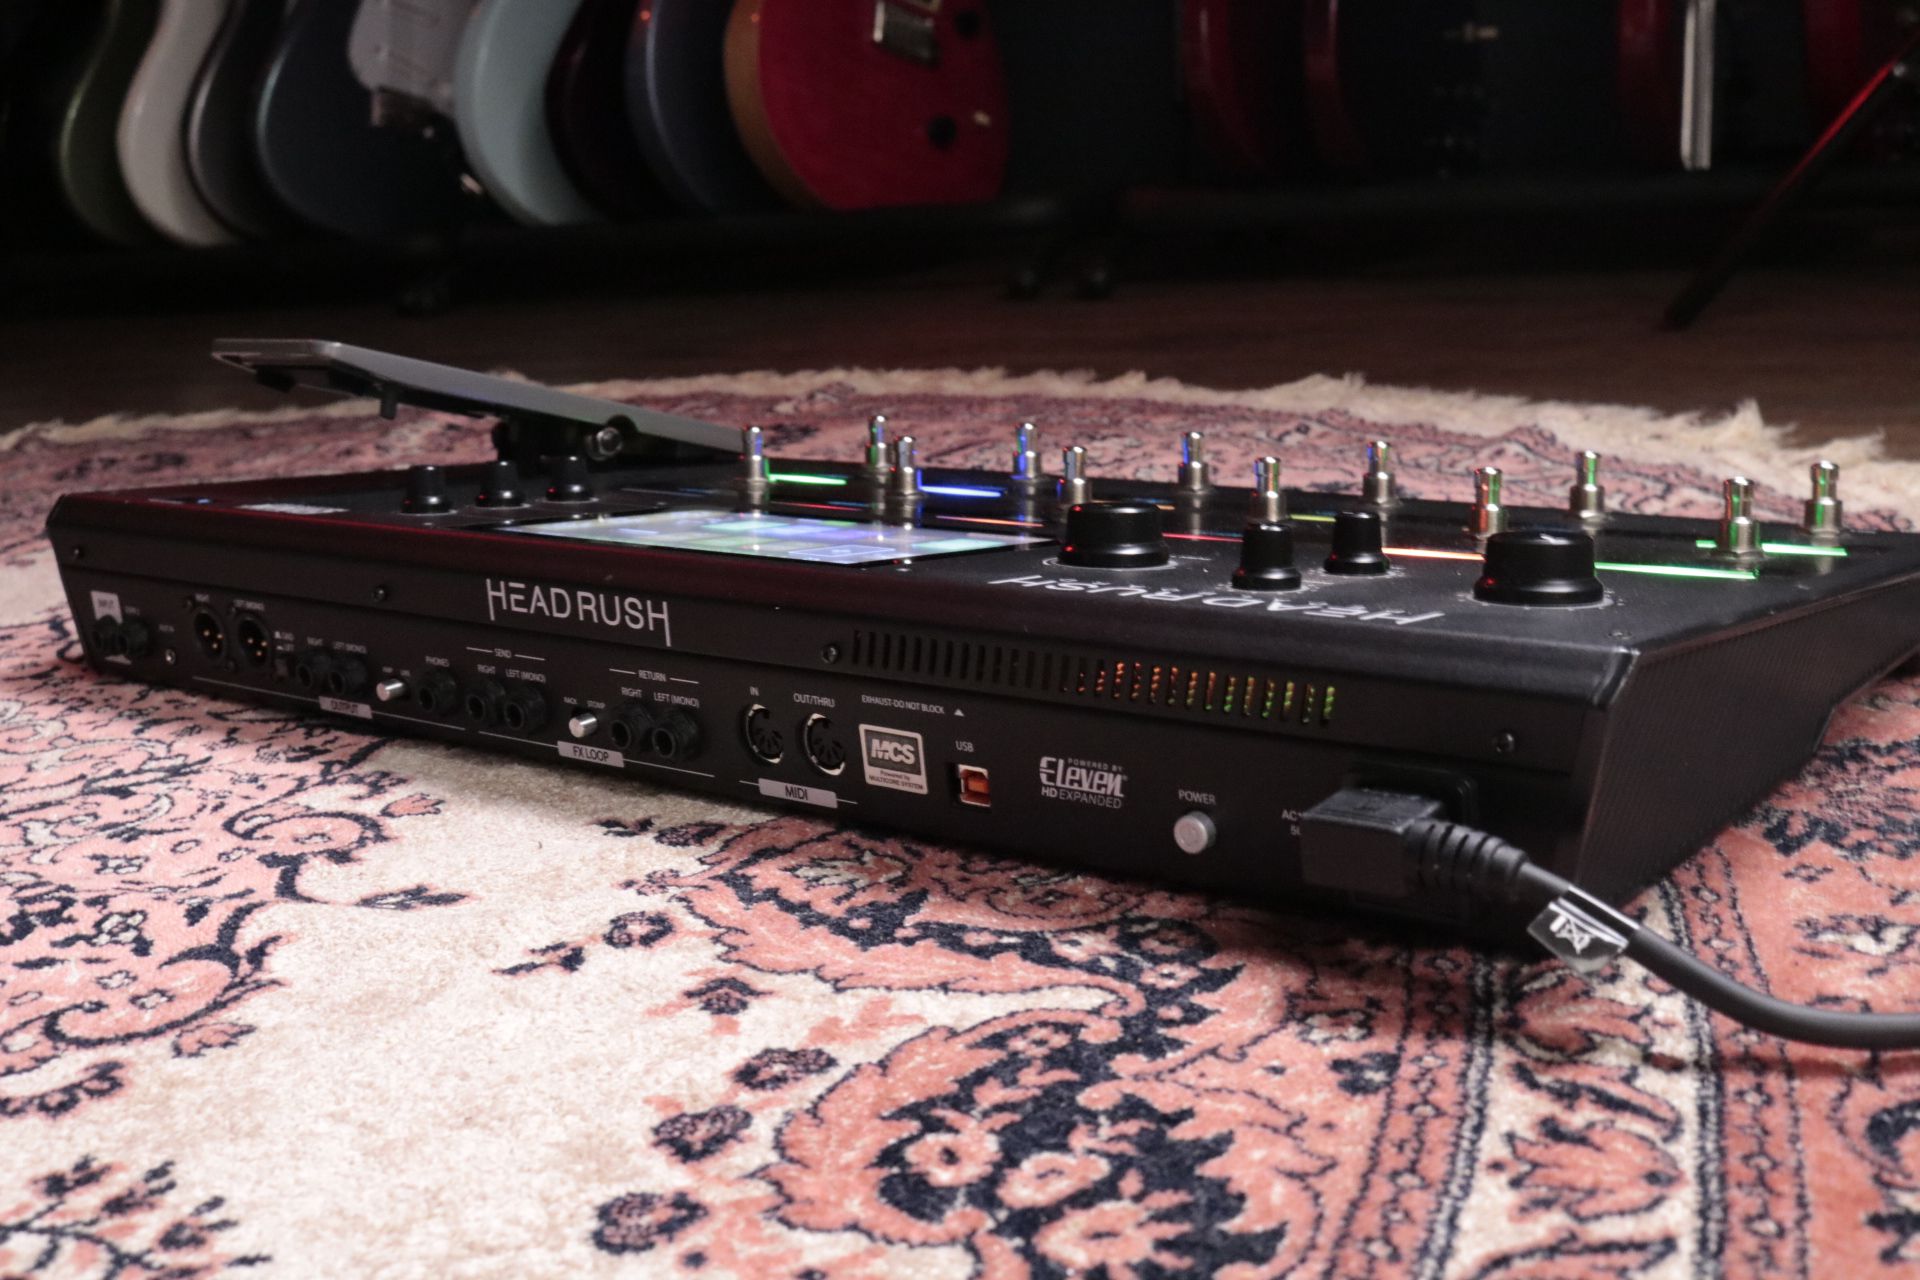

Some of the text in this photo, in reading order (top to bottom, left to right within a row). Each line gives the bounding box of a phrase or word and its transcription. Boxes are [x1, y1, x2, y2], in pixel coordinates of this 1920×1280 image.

[988, 574, 1445, 624] HEADRUSH
[486, 578, 671, 647] HEADRUSH
[425, 655, 450, 667] PHONES
[494, 648, 512, 659] SEND
[477, 664, 496, 675] RIGHT
[505, 669, 546, 684] LEFT (MONO)
[638, 669, 667, 682] RETURN
[621, 686, 643, 698] RIGHT
[750, 686, 759, 697] IN
[653, 692, 700, 708] LEFT (MONO)
[793, 692, 835, 708] OUT/THRU
[905, 701, 920, 711] NOT
[921, 703, 945, 714] BLOCK
[572, 745, 609, 762] FX LOOP
[871, 739, 915, 765] MCS
[955, 740, 975, 753] USB
[1068, 758, 1123, 772] POWERED BY
[785, 785, 808, 801] MIDI
[1041, 786, 1122, 809] HD EXPANDED
[1178, 789, 1216, 805] POWER
